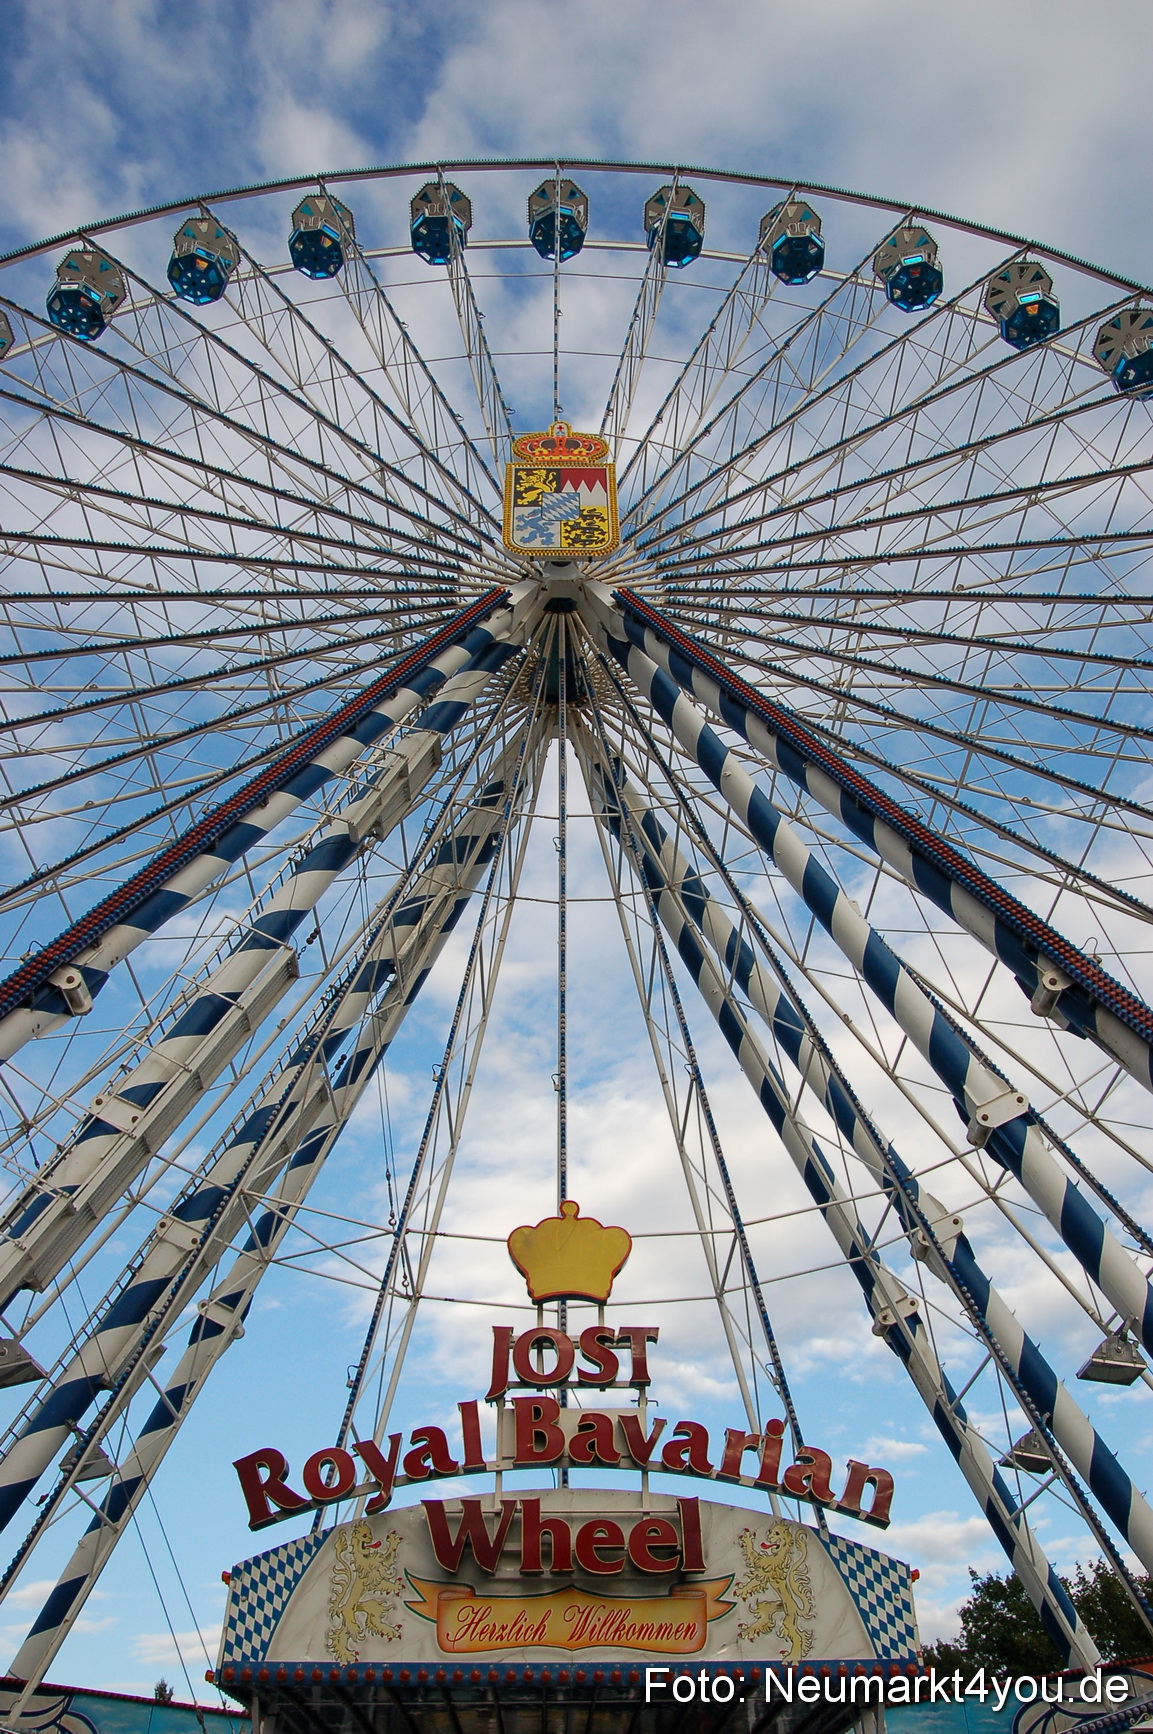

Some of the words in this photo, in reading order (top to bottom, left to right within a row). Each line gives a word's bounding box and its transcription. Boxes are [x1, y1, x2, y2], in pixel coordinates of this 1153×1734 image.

[487, 1325, 659, 1402] JOST
[232, 1400, 487, 1531] Royal
[512, 1396, 894, 1530] Bavarian
[422, 1497, 707, 1575] Wheel
[446, 1604, 552, 1643] Herzlich
[563, 1604, 698, 1643] Willkommen
